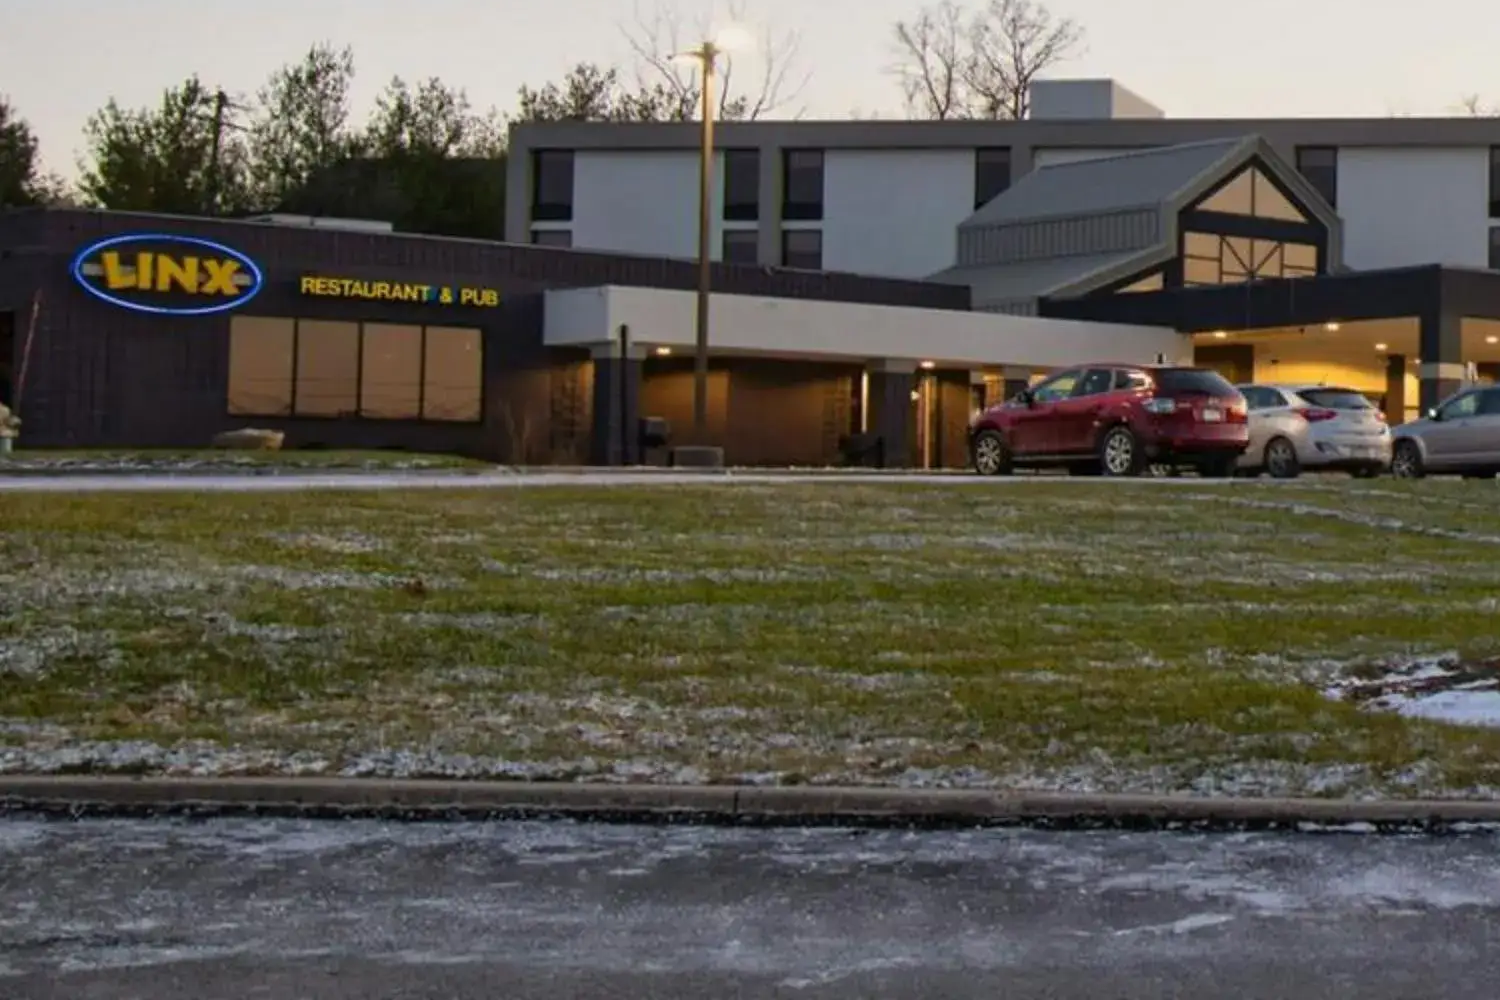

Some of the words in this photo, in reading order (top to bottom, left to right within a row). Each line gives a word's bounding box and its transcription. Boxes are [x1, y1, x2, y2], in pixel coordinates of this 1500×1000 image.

[100, 252, 242, 296] LINX
[301, 276, 430, 302] RESTAURANT
[439, 290, 453, 304] &
[461, 291, 498, 306] PUB
